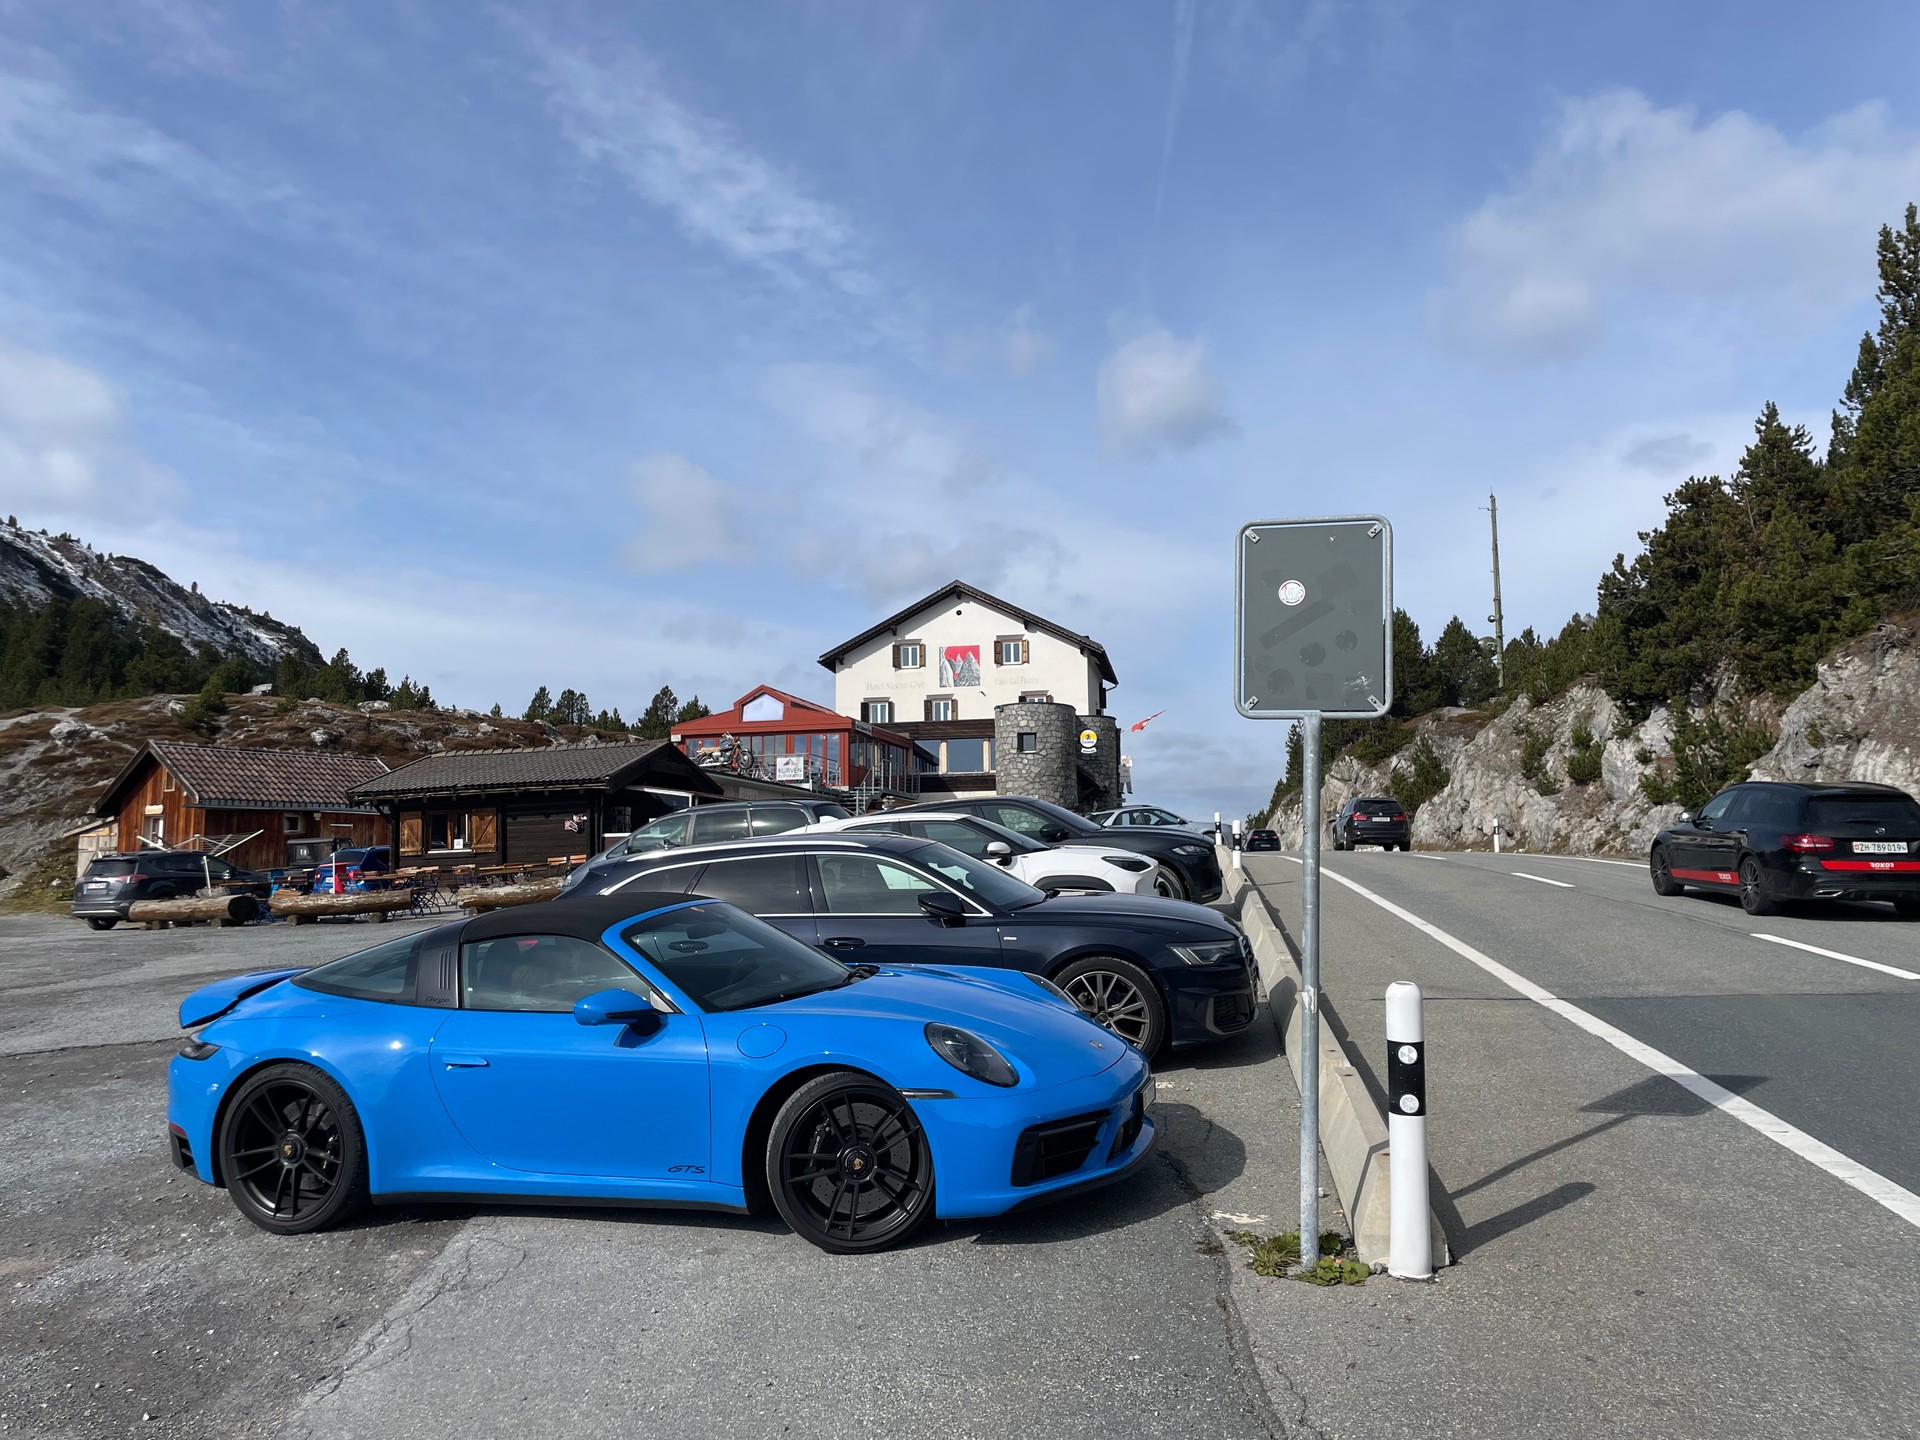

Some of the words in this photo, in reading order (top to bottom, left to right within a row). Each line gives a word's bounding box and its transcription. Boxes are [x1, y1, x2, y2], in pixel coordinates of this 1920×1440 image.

[866, 682, 885, 691] Hotel
[1860, 843, 1870, 851] ZH
[667, 1165, 706, 1174] GTS
